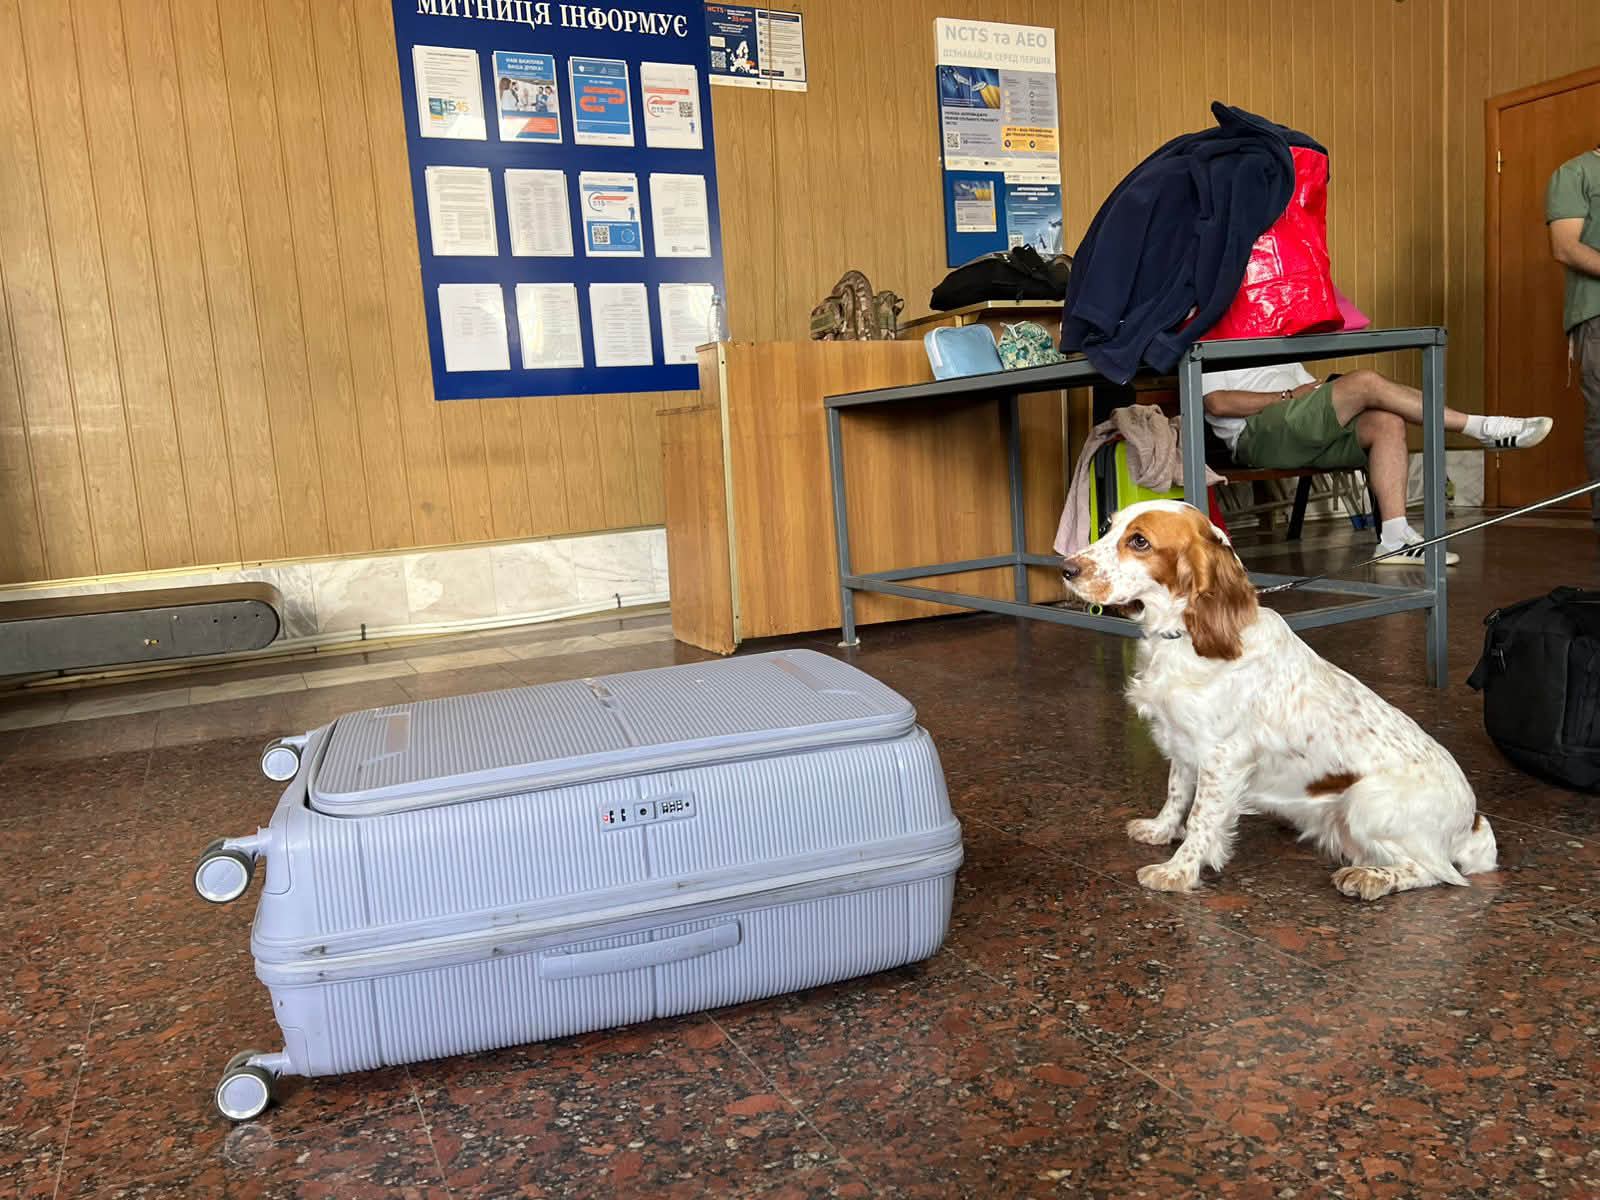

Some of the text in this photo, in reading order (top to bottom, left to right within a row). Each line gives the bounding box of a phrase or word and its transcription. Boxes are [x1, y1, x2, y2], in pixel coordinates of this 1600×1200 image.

[417, 0, 688, 37] МИТНИЦЯ ІНФОРМУЄ
[945, 26, 988, 42] NCTS
[993, 33, 1010, 45] та
